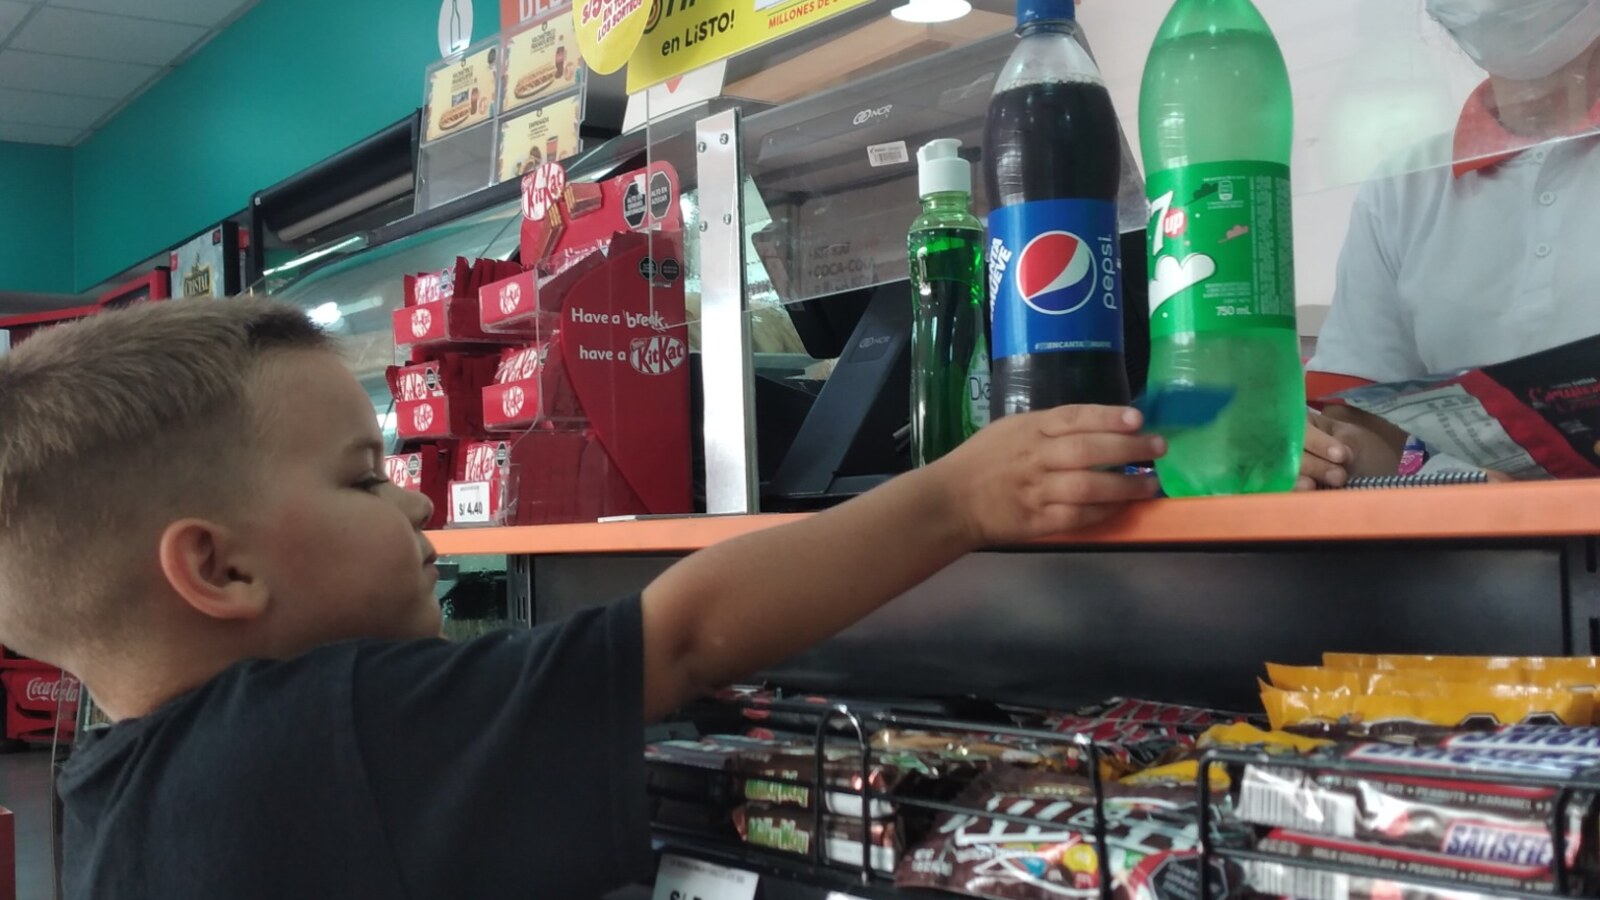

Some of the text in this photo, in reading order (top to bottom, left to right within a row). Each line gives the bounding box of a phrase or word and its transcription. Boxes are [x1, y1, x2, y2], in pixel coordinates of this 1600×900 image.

[768, 2, 815, 29] MILLONES
[662, 35, 680, 56] en
[571, 307, 609, 324] Have
[611, 314, 621, 324] a
[1215, 305, 1235, 317] 750
[579, 335, 686, 376] have a KitKat
[467, 501, 483, 515] 4.40
[1446, 824, 1553, 866] SATISFIE
